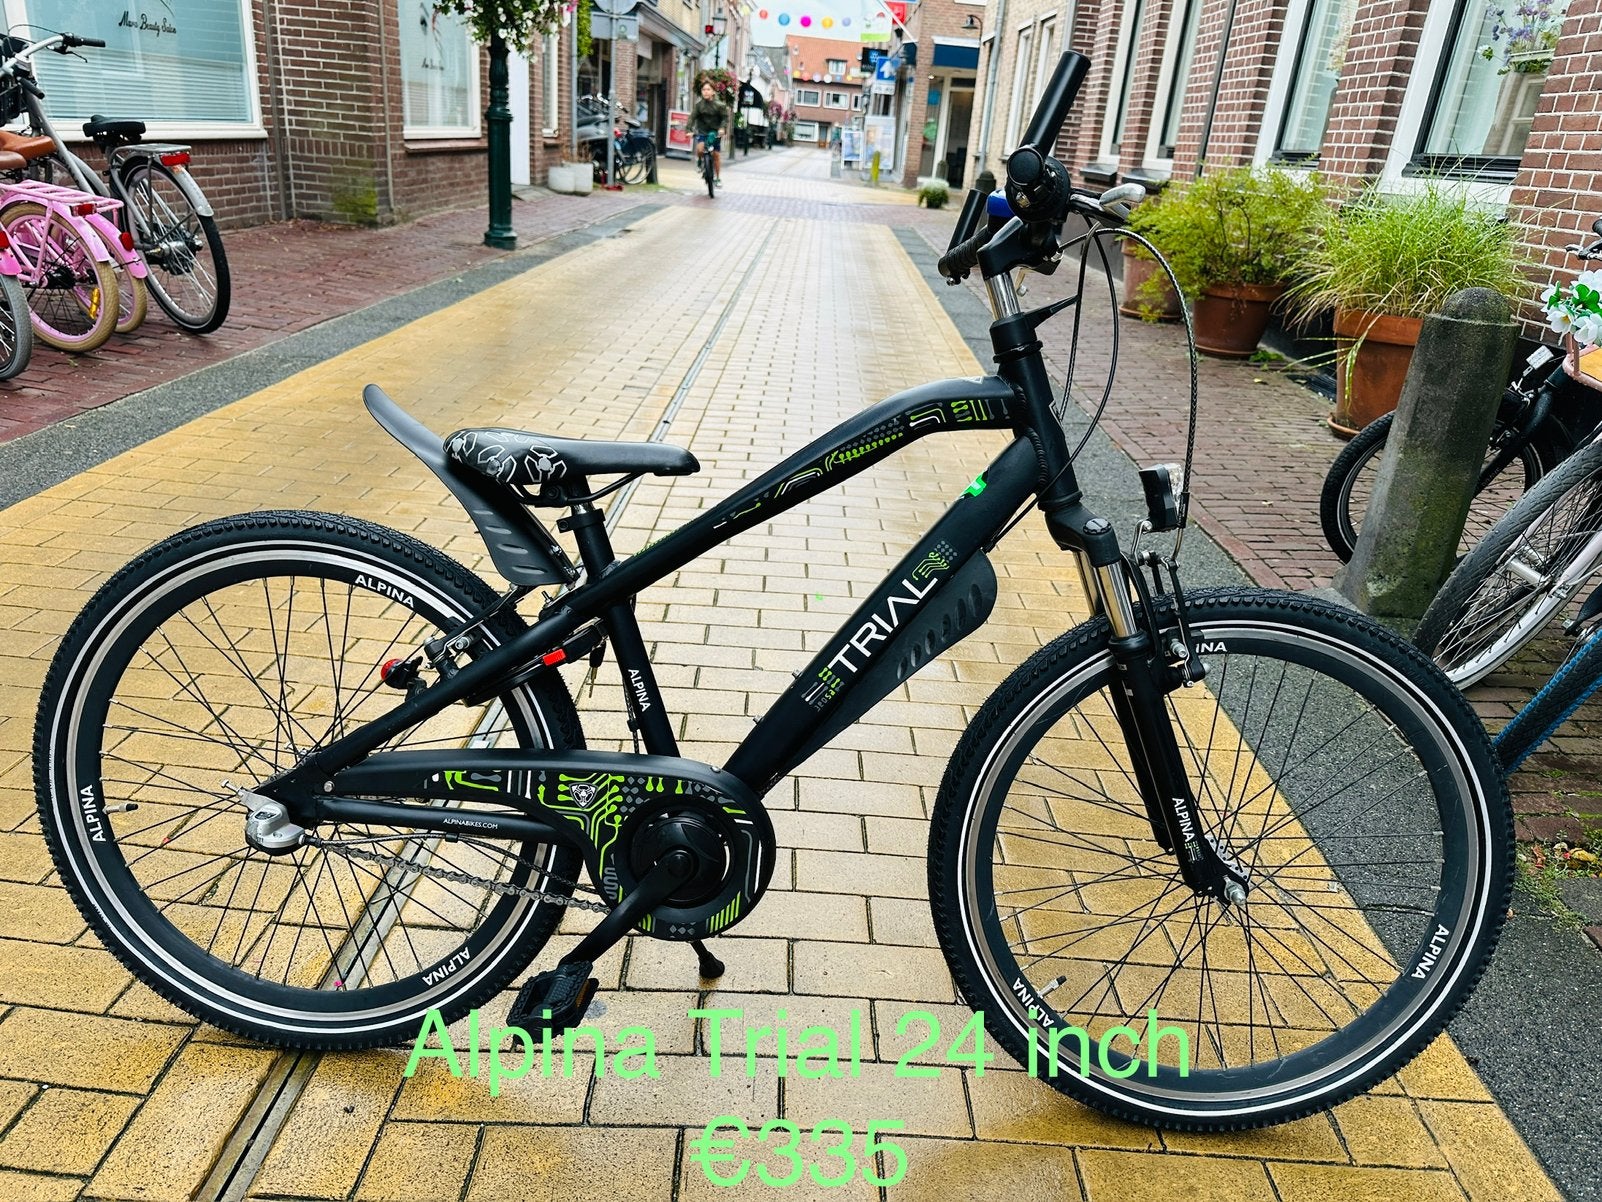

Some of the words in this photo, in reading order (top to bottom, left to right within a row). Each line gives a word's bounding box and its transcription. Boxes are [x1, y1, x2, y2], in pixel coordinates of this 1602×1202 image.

[139, 13, 160, 38] Beauty
[161, 17, 177, 34] Salon
[354, 574, 415, 608] ALPINA
[826, 577, 938, 673] TRIAL
[1195, 641, 1228, 653] INA
[627, 669, 652, 712] ALPINA
[80, 784, 107, 842] ALPINA
[442, 818, 498, 829] ALPINABIKES.COM
[1171, 797, 1196, 842] ALPINA
[421, 946, 471, 986] ALPINA
[1410, 923, 1450, 979] ALPINA
[1012, 977, 1055, 1028] ALPINA
